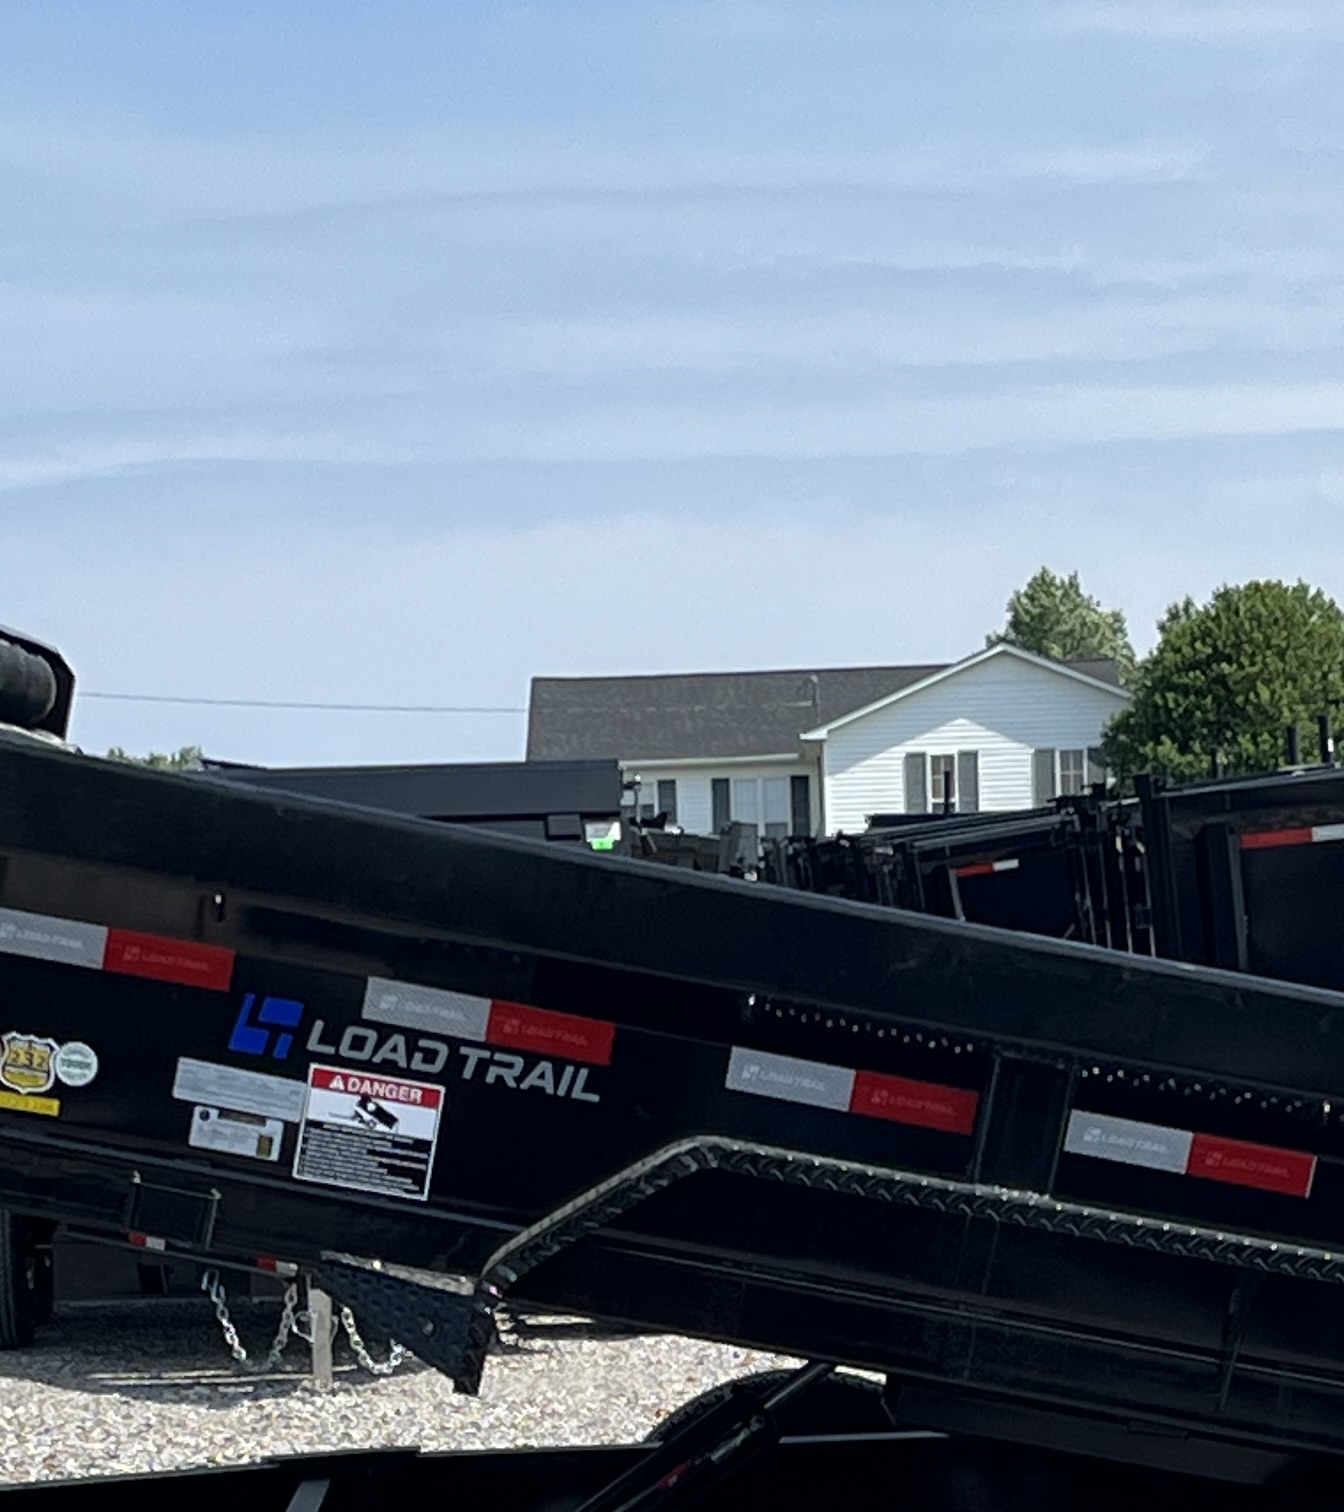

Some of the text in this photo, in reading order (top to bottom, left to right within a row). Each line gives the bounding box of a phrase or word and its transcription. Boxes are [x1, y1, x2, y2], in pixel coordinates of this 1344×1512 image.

[306, 1019, 600, 1103] LOAD TRAIL
[346, 1077, 423, 1104] DANGER
